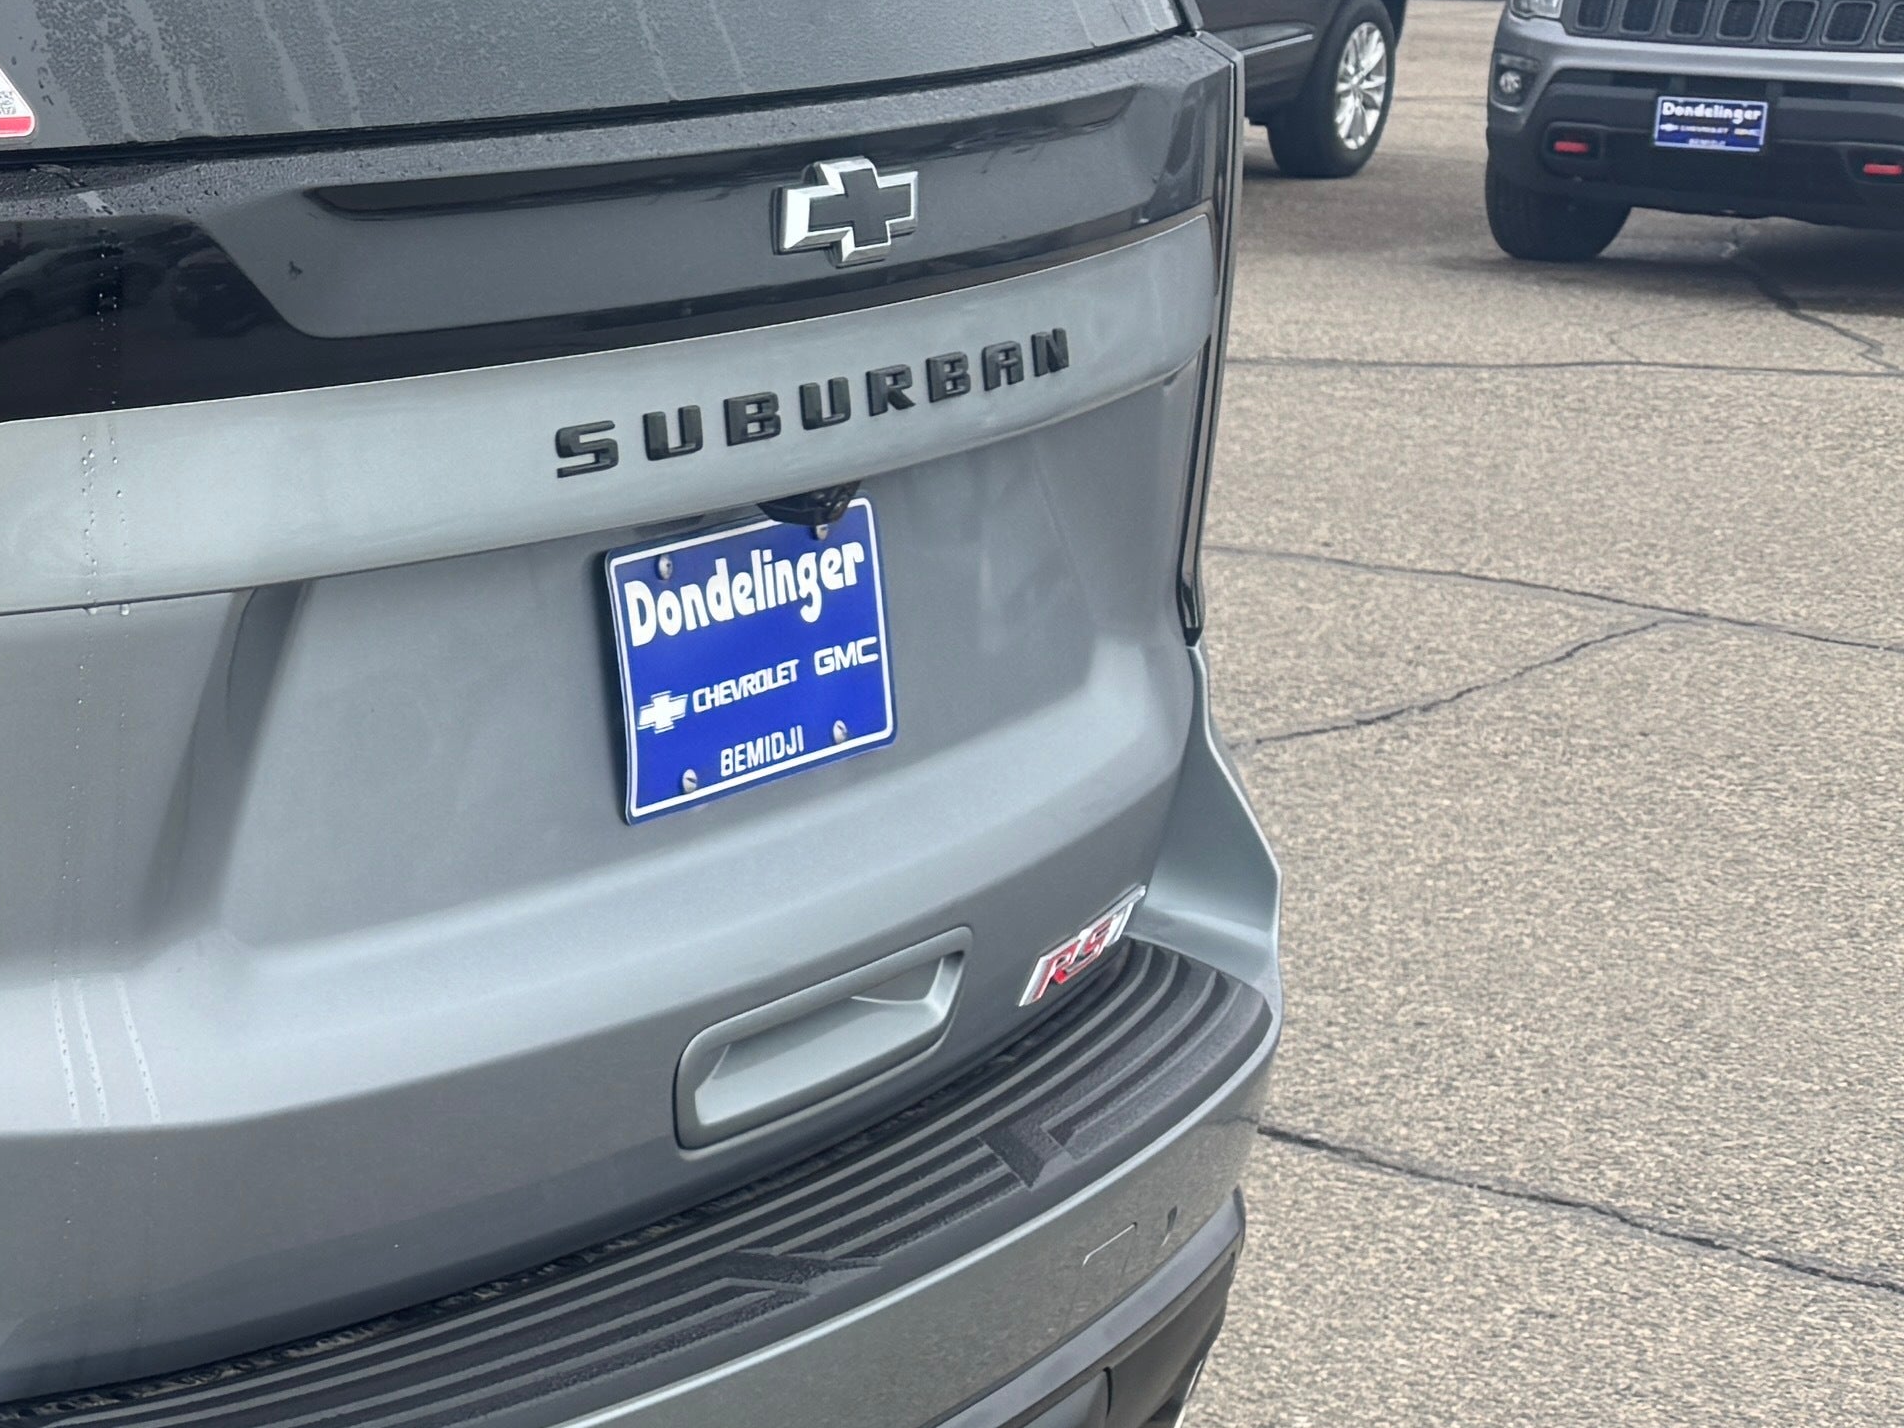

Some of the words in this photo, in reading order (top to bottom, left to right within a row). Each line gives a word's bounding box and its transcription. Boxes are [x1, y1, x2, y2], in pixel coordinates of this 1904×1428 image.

[1662, 102, 1762, 124] Dondelinger
[554, 327, 1070, 479] SUBURBAN
[623, 541, 865, 647] Dondelinger
[692, 658, 800, 713] CHEVROLET
[814, 636, 879, 676] GMC
[720, 725, 804, 777] BEMIDJI
[1018, 883, 1147, 1007] RST
